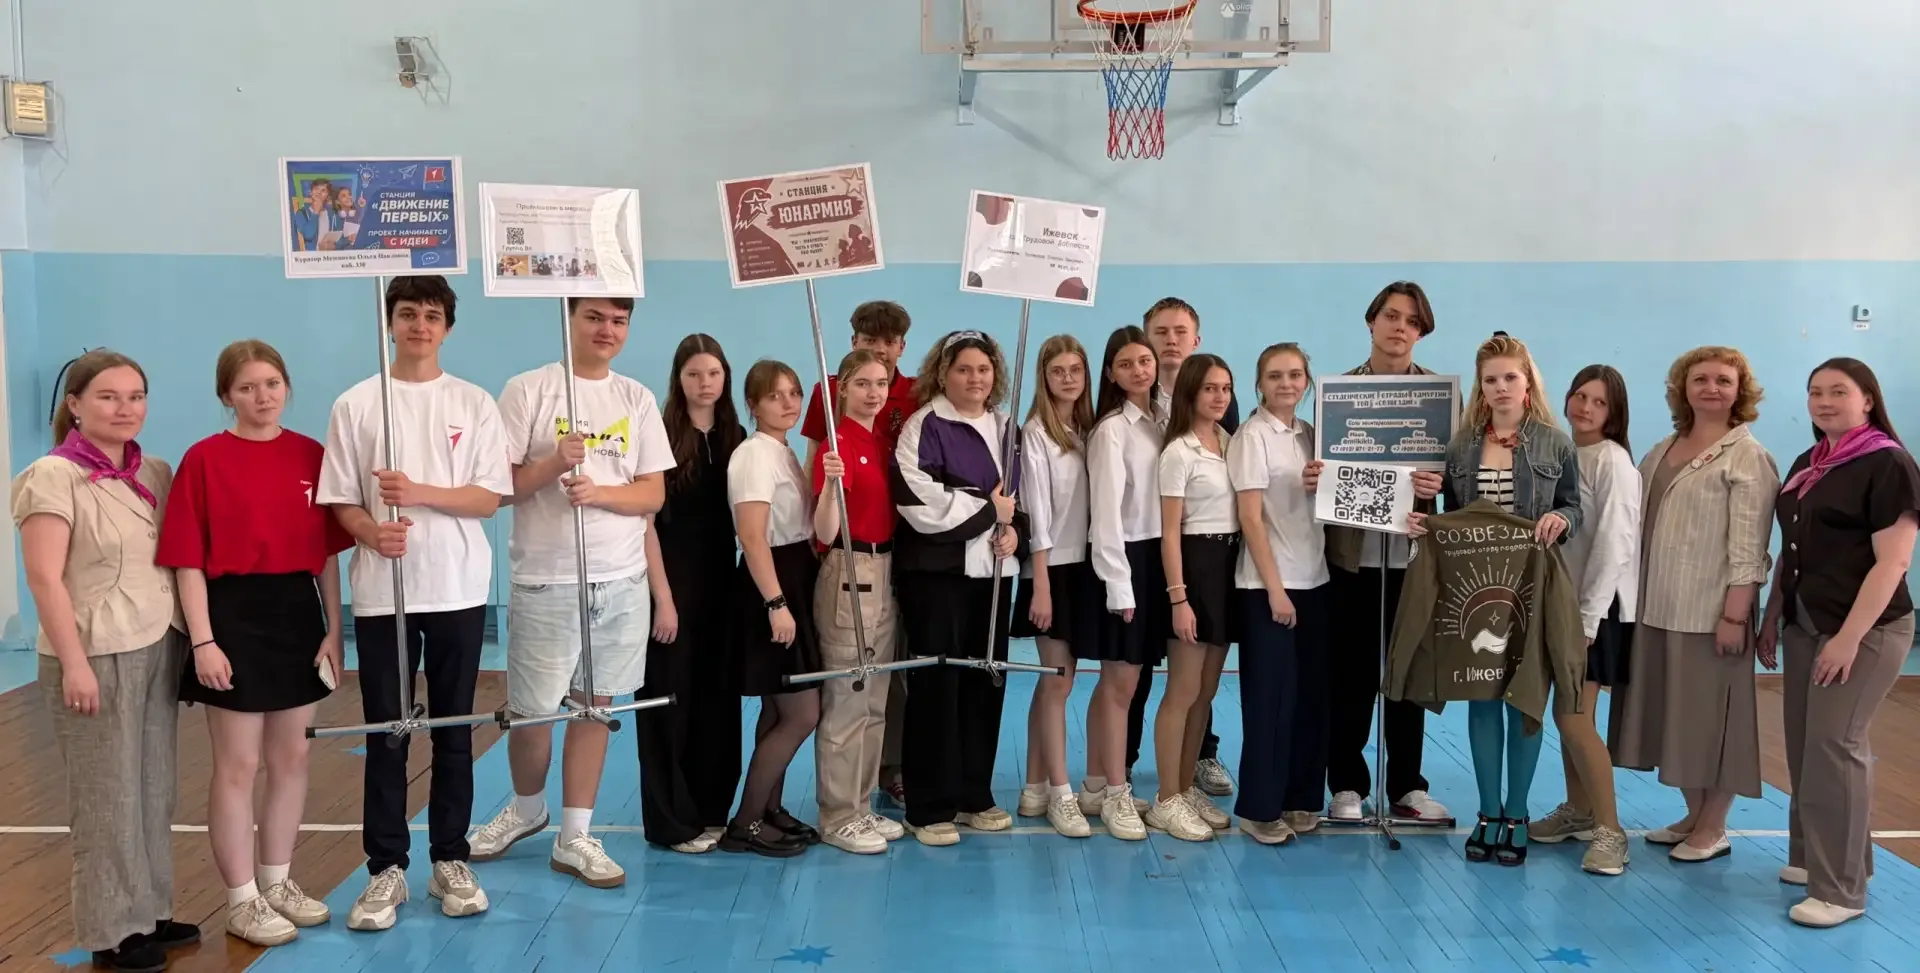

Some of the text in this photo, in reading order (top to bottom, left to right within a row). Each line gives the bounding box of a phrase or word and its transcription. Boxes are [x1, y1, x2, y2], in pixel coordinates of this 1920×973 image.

[787, 184, 828, 198] СТАНЦИЯ
[372, 199, 449, 211] «ДВИЖЕНИЕ
[381, 211, 449, 223] ПЕРВЫХ»
[778, 199, 854, 224] ЮНАРМИЯ
[1043, 227, 1078, 240] Ижевск
[390, 237, 429, 246] С ИДЕИ
[1023, 235, 1055, 245] Трудовой
[555, 417, 589, 427] ВРМЯ
[594, 448, 627, 459] НОВЫХ
[1435, 524, 1535, 545] СОЗВЕЗДИ
